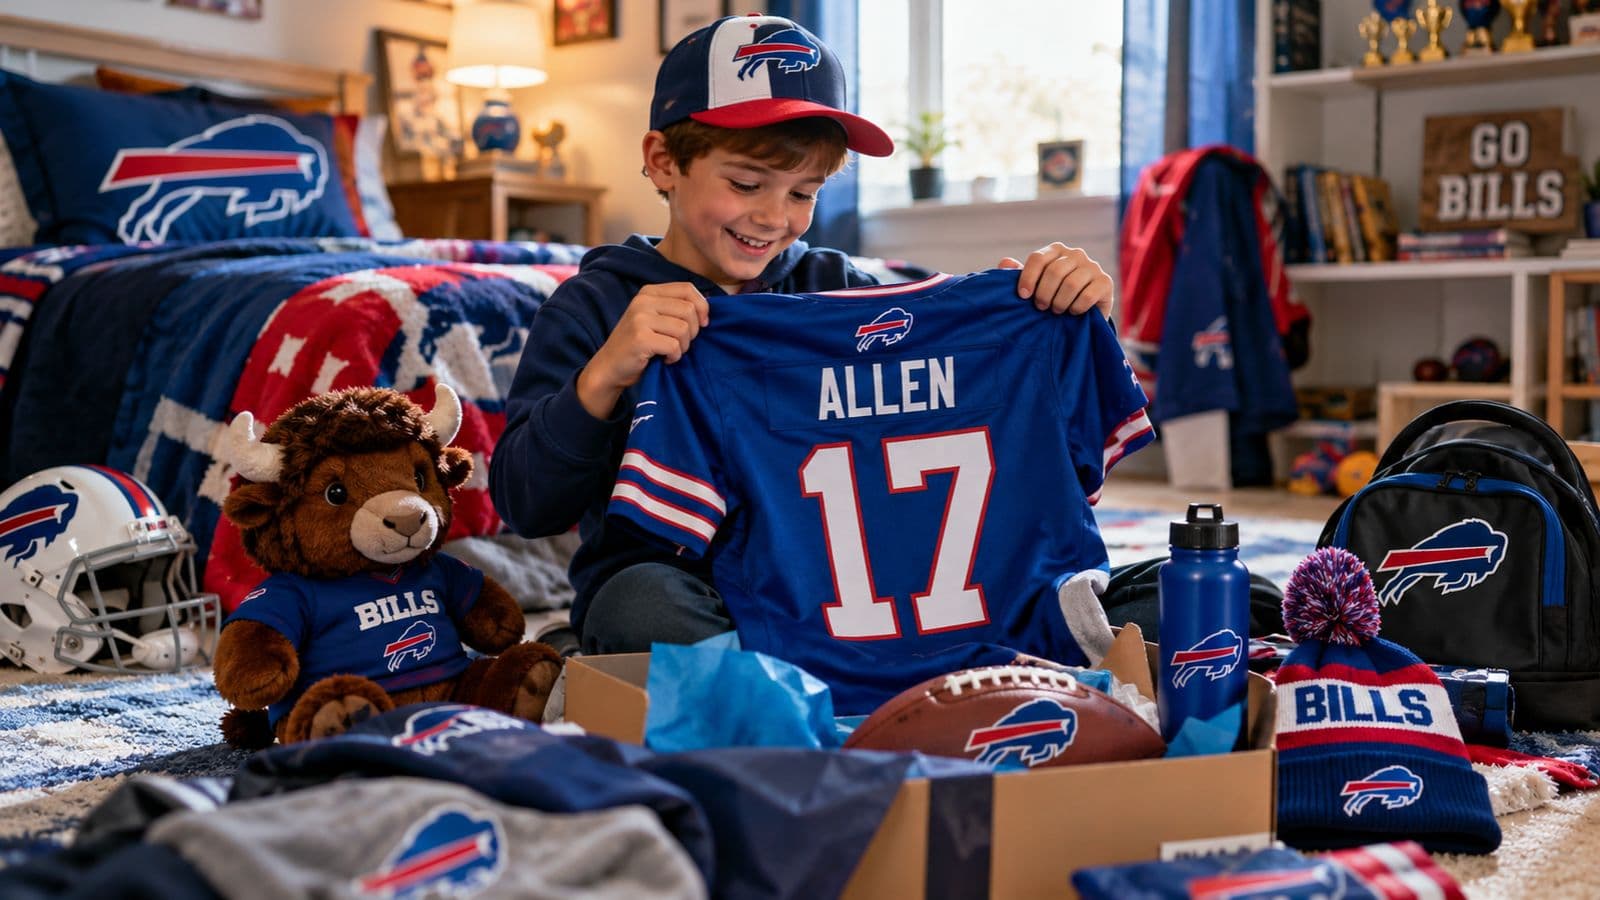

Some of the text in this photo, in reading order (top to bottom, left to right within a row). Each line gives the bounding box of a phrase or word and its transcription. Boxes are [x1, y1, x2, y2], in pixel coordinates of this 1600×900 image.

[1470, 120, 1530, 168] GO
[1438, 170, 1564, 221] BILLS
[818, 356, 956, 421] ALLEN
[797, 425, 996, 641] 17
[353, 589, 440, 632] BILLS
[1294, 684, 1434, 727] BILLS
